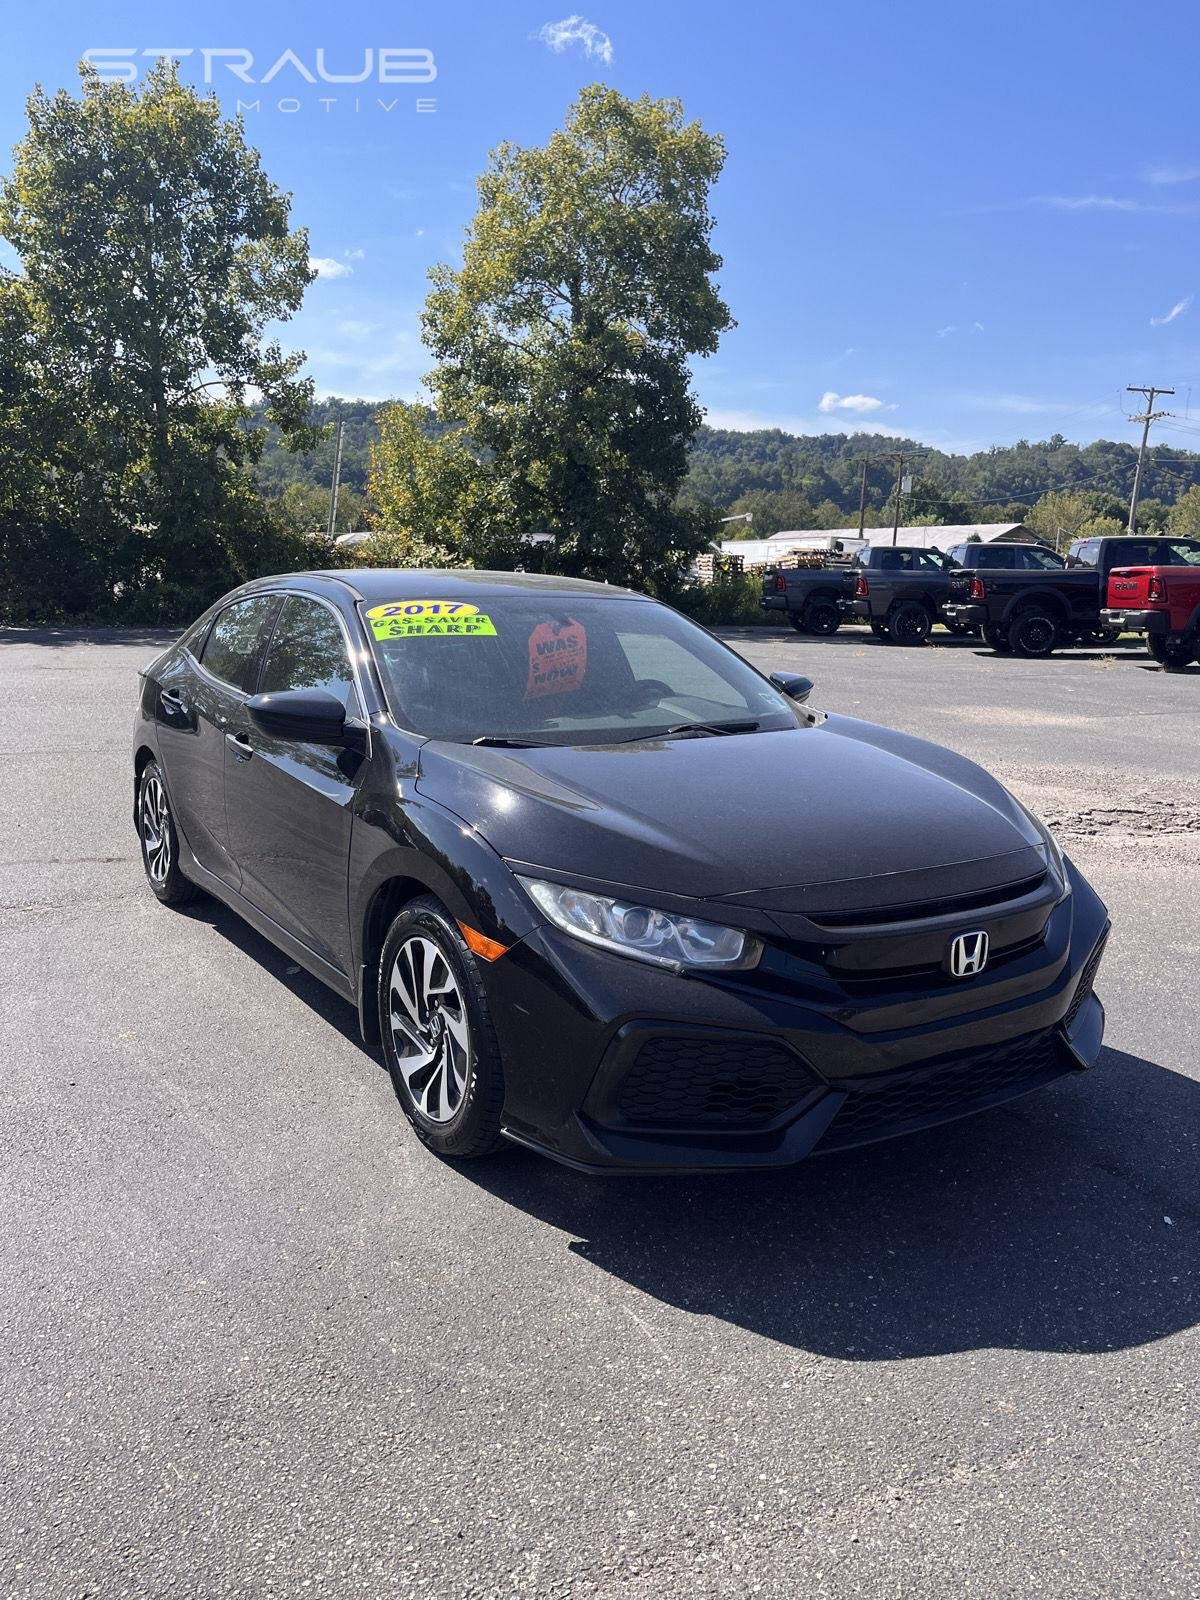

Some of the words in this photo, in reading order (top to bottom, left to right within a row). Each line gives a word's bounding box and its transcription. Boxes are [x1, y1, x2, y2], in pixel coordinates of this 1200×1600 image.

[1114, 582, 1137, 591] RAM
[381, 605, 464, 617] 2017
[373, 616, 488, 628] GAS-SAVER
[389, 624, 480, 636] SHARP
[536, 635, 578, 656] WAS
[534, 665, 577, 684] NOW
